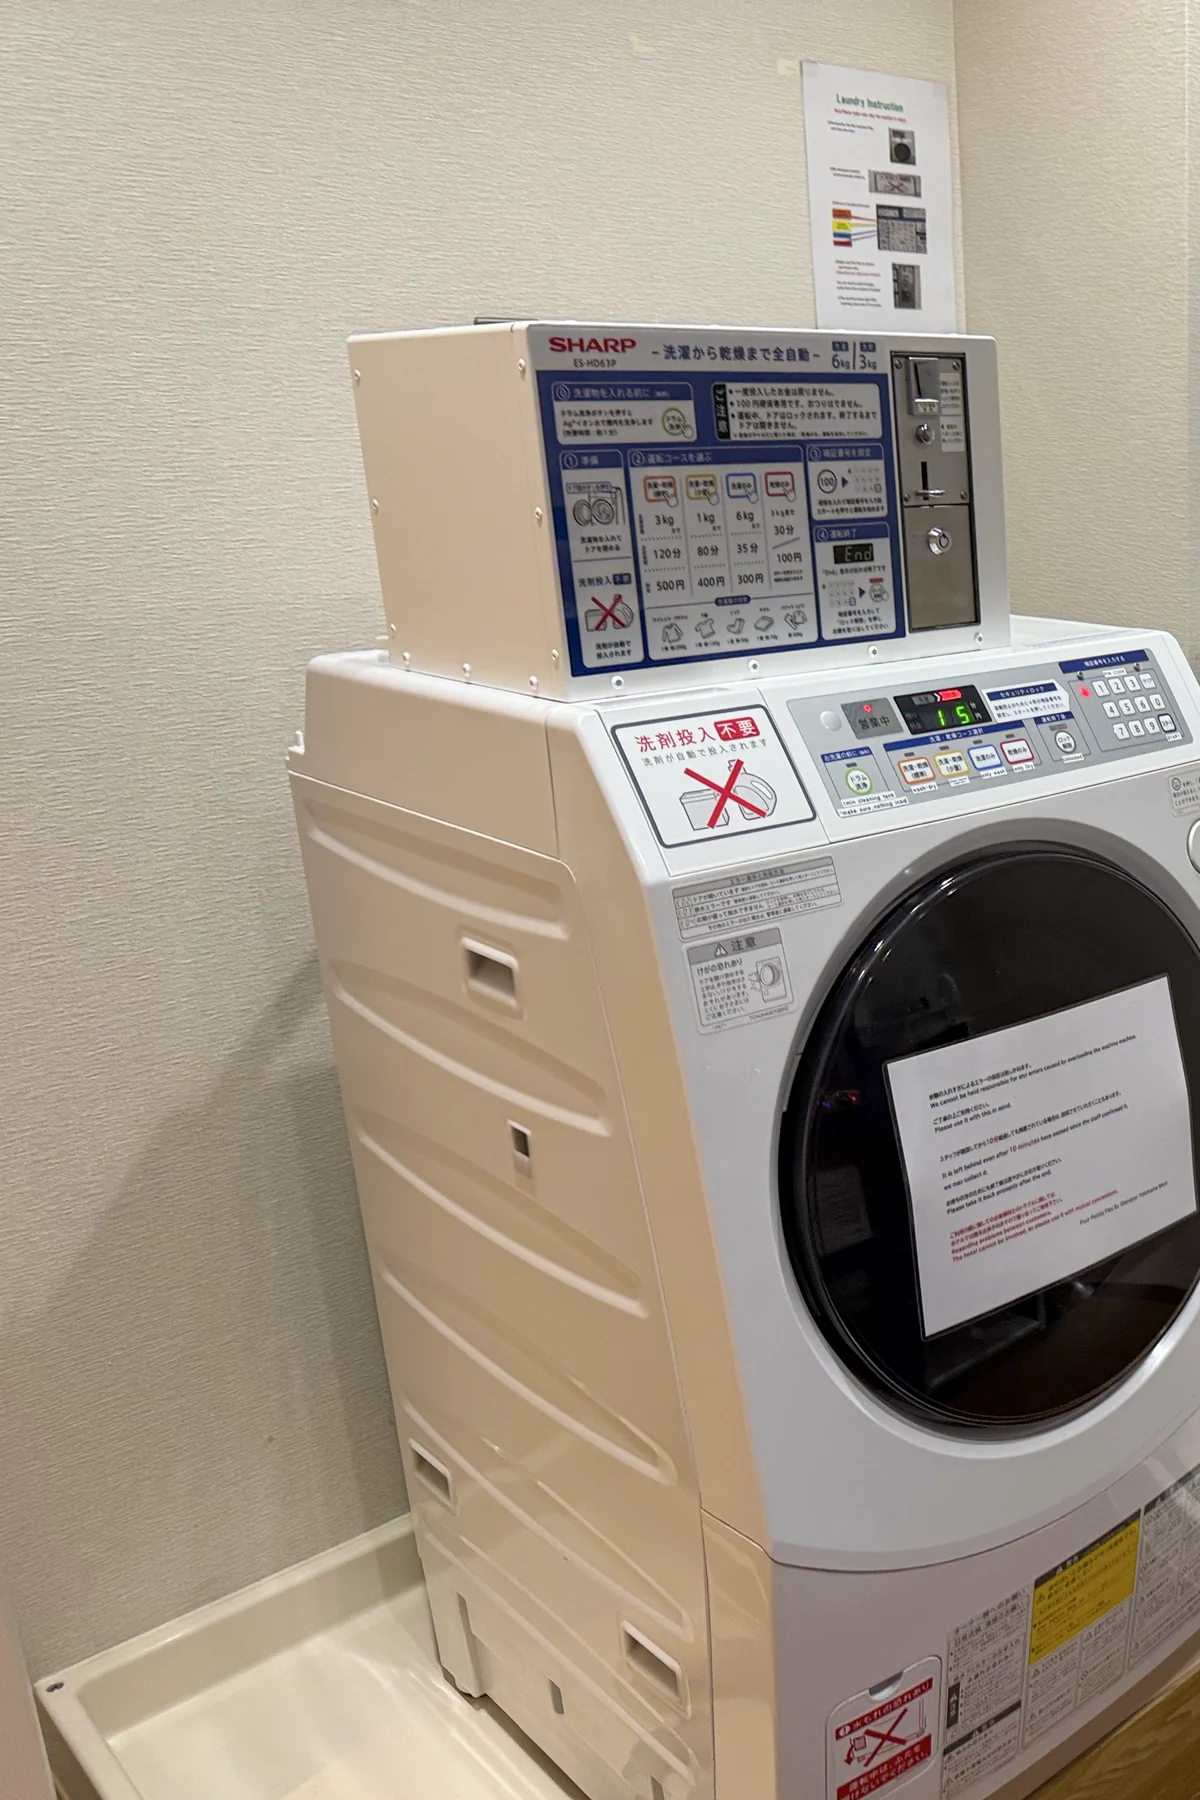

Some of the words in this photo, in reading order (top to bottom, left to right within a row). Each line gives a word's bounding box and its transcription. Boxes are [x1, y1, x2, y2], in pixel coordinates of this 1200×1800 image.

[836, 93, 865, 108] Laundry
[867, 98, 904, 112] Instruction
[548, 336, 637, 353] SHARP
[573, 358, 617, 369] ES-HD63P
[832, 353, 850, 370] 6kg
[859, 354, 877, 370] 3kg
[820, 477, 834, 486] 100
[655, 514, 675, 527] 3kg
[697, 512, 715, 524] 1kg
[736, 510, 754, 521] 6kg
[653, 548, 681, 559] 120分
[697, 545, 719, 557] 80分
[736, 543, 759, 554] 35分
[844, 546, 872, 562] End
[777, 552, 802, 563] 100円
[697, 576, 725, 588] 400円
[737, 573, 764, 584] 300円
[656, 579, 685, 592] 500円
[999, 685, 1045, 697] セキュリティロック
[1097, 684, 1104, 692] 1
[1113, 681, 1121, 690] 2
[1129, 679, 1136, 687] 3
[1107, 705, 1115, 713] 4
[1123, 702, 1131, 711] 5
[1138, 700, 1146, 708] 6
[859, 715, 891, 730] 営業中
[1117, 727, 1125, 735] 7
[1133, 724, 1141, 732] 8
[1148, 721, 1156, 730] 9
[635, 727, 715, 753] 洗剤投入
[717, 720, 757, 739] 不要
[643, 738, 768, 767] 洗剤が自動で投入されます
[1007, 746, 1028, 755] 乾燥のみ
[974, 752, 996, 762] 洗濯のみ
[848, 773, 867, 782] ドラム
[912, 783, 937, 793] wash-dry
[856, 793, 881, 804] cleaning
[730, 934, 757, 952] 注意
[939, 1094, 958, 1106] cannot
[959, 1091, 966, 1100] be
[967, 1087, 979, 1097] held
[979, 1077, 1008, 1093] responsible
[1009, 1074, 1017, 1082] for
[1028, 1065, 1042, 1076] errors
[934, 1122, 952, 1134] Please
[953, 1118, 963, 1127] use
[969, 1112, 980, 1122] with
[981, 1108, 991, 1117] this
[953, 1165, 963, 1175] left
[963, 1158, 982, 1171] behind
[982, 1153, 995, 1163] even
[995, 1148, 1008, 1158] after
[1009, 1144, 1017, 1153] 10
[1040, 1131, 1051, 1141] have
[964, 1171, 982, 1183] collect
[947, 1203, 964, 1215] Please
[965, 1198, 977, 1208] take
[983, 1190, 995, 1201] back
[1019, 1176, 1031, 1186] after
[1032, 1172, 1040, 1181] the
